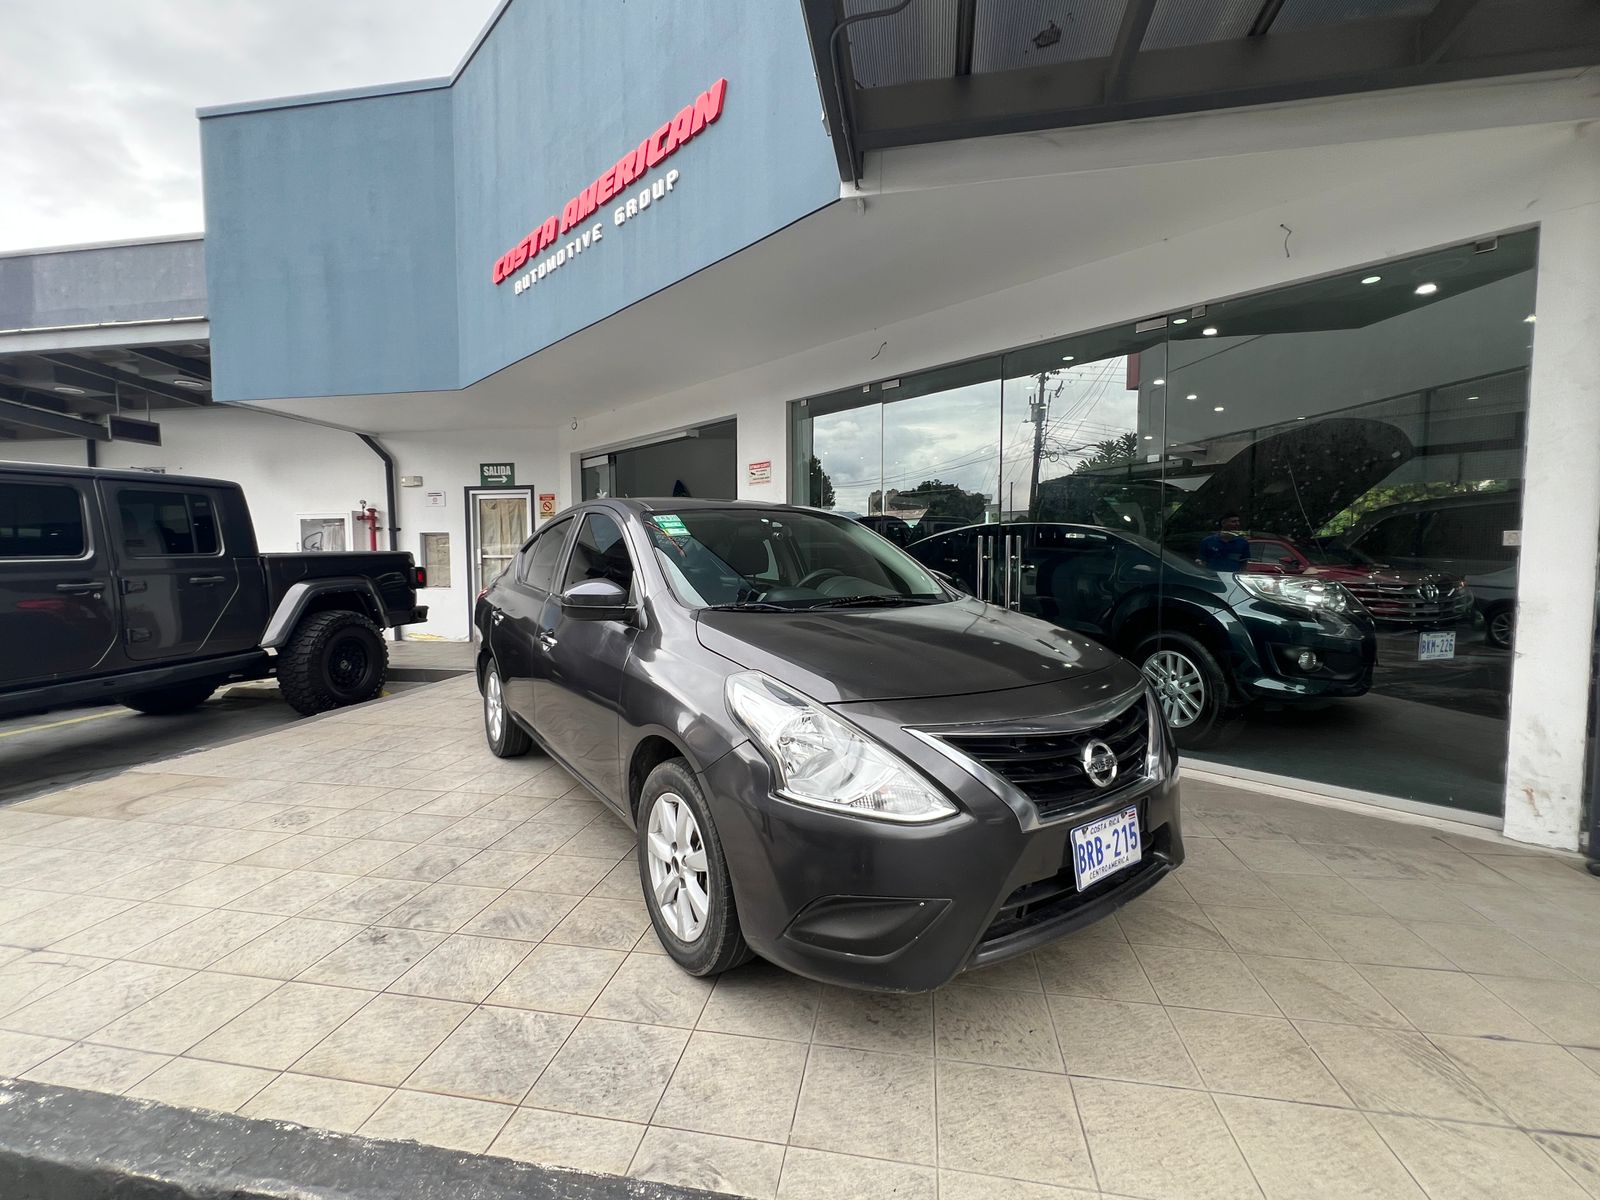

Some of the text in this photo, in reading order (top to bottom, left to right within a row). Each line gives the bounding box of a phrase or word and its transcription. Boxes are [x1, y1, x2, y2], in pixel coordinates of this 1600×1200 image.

[492, 77, 728, 285] COSTA AMERICAN
[514, 168, 680, 296] AUTOMOTIVE GROUP
[483, 465, 512, 476] SALIDA
[1421, 639, 1454, 654] BKM-226
[1090, 817, 1120, 835] COSTA RICA
[1077, 821, 1138, 875] BRB-215
[1089, 855, 1130, 880] CENTROAMERICA
